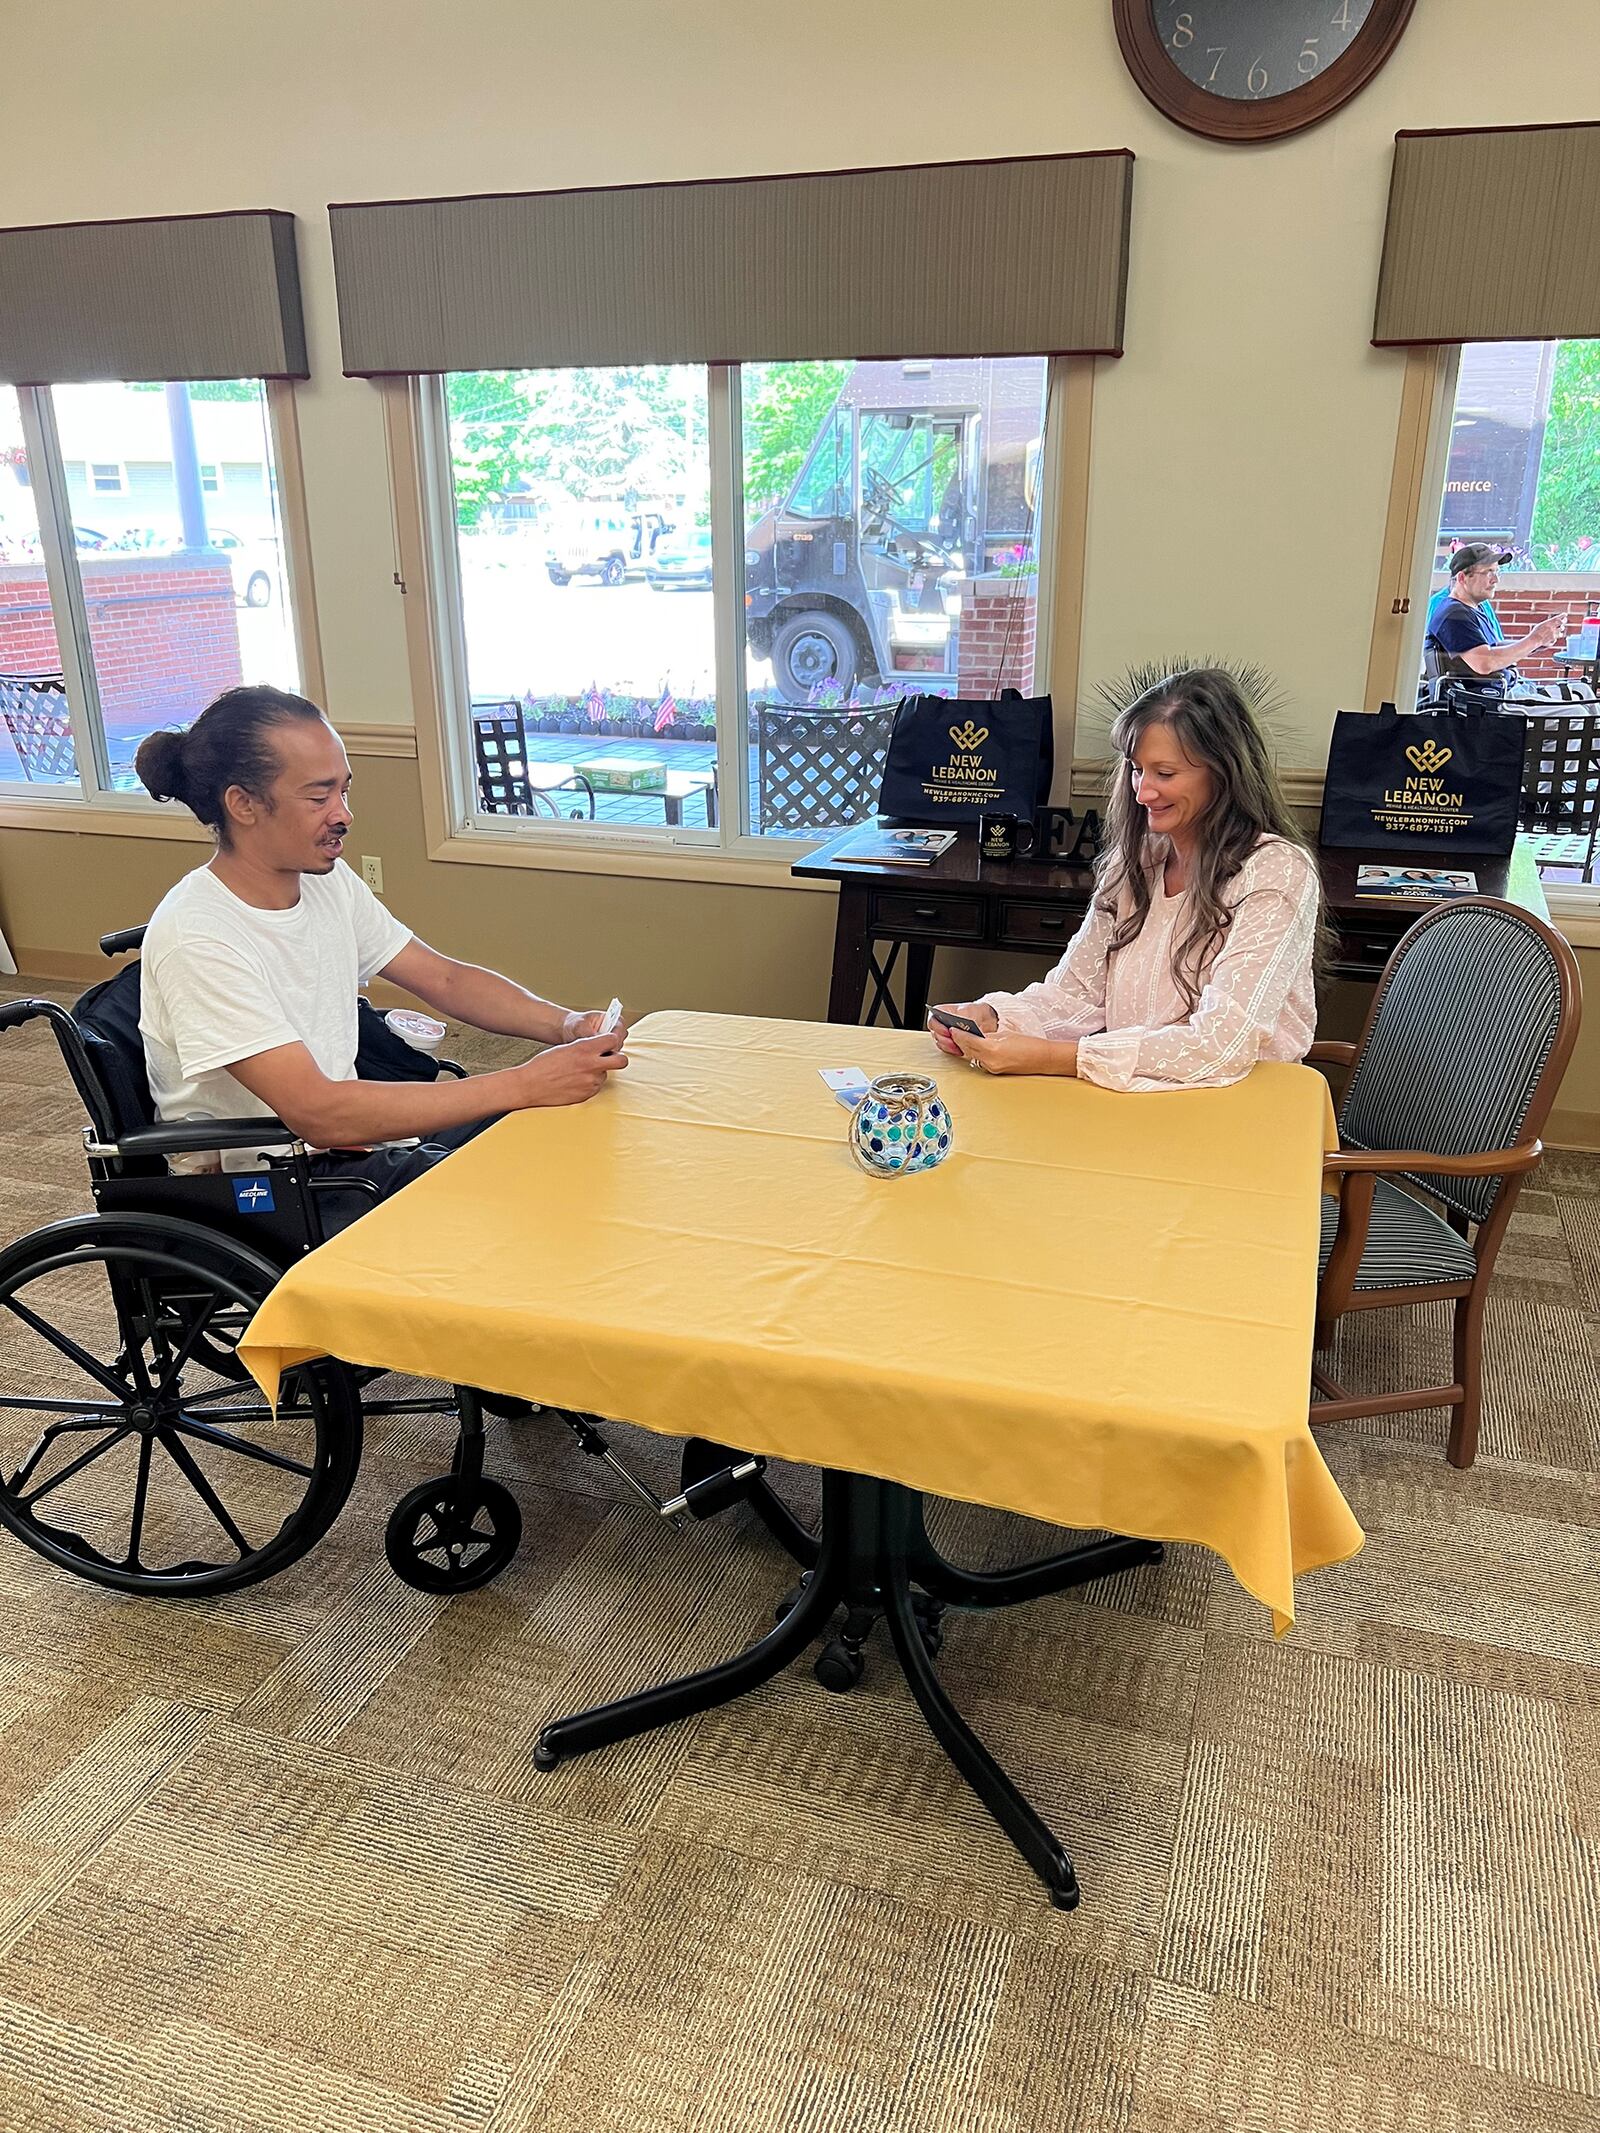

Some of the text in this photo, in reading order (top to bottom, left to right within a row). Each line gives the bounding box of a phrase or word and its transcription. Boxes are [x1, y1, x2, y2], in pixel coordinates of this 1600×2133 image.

[1330, 0, 1352, 31] 4
[1173, 13, 1194, 48] 8
[1297, 38, 1320, 73] 5
[1206, 46, 1227, 81] 7
[1247, 55, 1268, 93] 6
[1444, 480, 1492, 492] merce
[950, 754, 983, 768] NEW
[932, 766, 997, 781] LEBANON
[1405, 776, 1445, 791] NEW
[1384, 789, 1463, 807] LEBANON
[1374, 815, 1468, 826] NEWLEBANONHC.COM
[1385, 822, 1454, 833] 937-687-1311
[239, 1190, 269, 1198] MEDLINE
